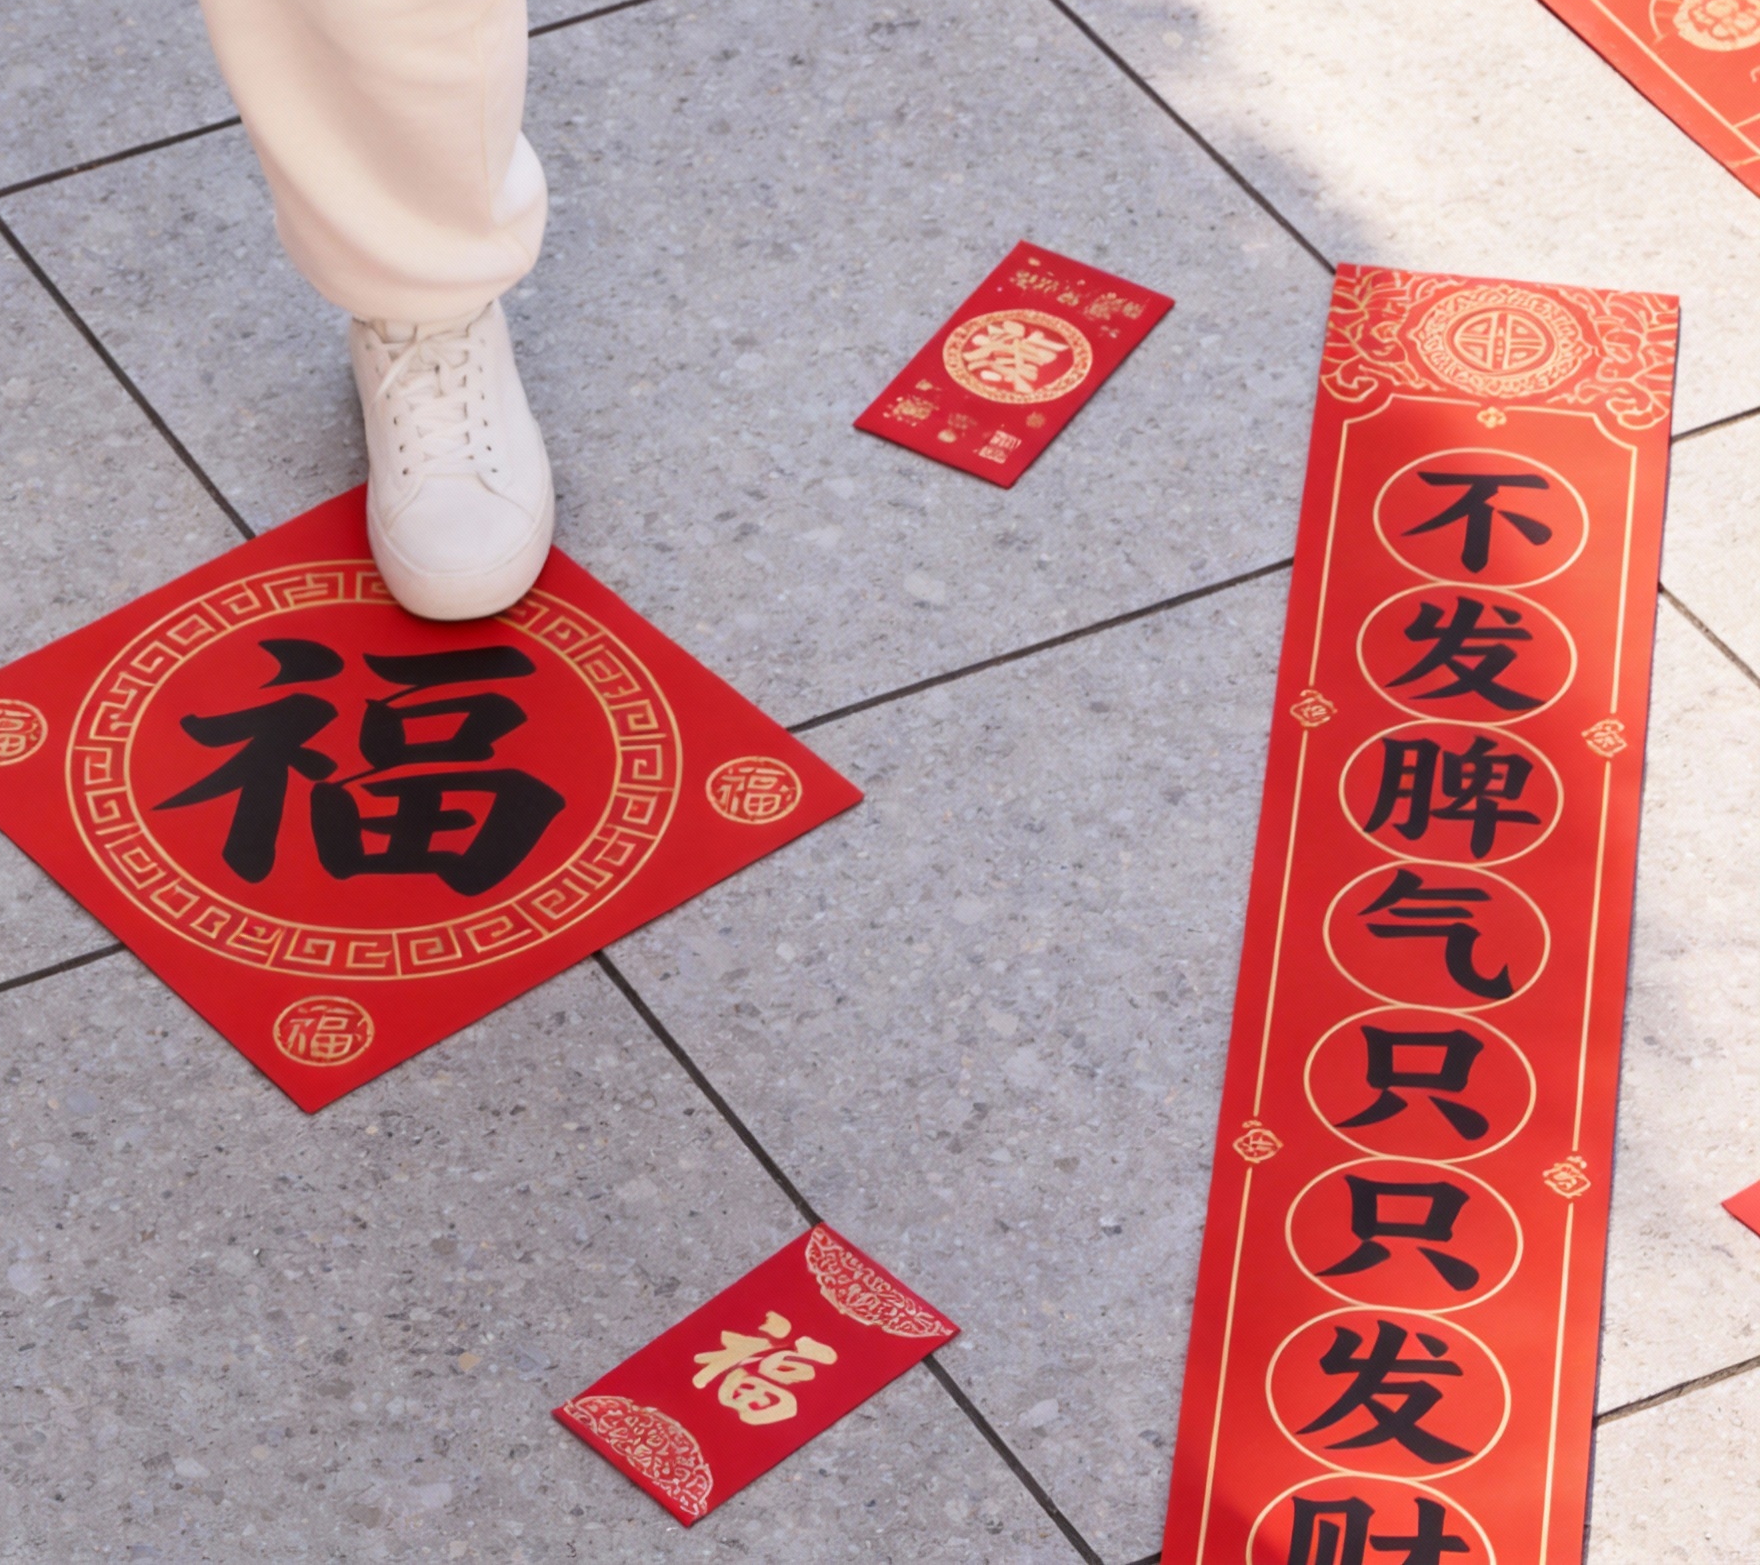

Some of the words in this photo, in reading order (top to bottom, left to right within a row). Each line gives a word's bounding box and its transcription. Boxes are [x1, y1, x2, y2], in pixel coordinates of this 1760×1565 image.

[152, 638, 567, 898] 福
[717, 766, 786, 816] 福
[286, 1004, 356, 1059] 福
[691, 1310, 839, 1426] 福
